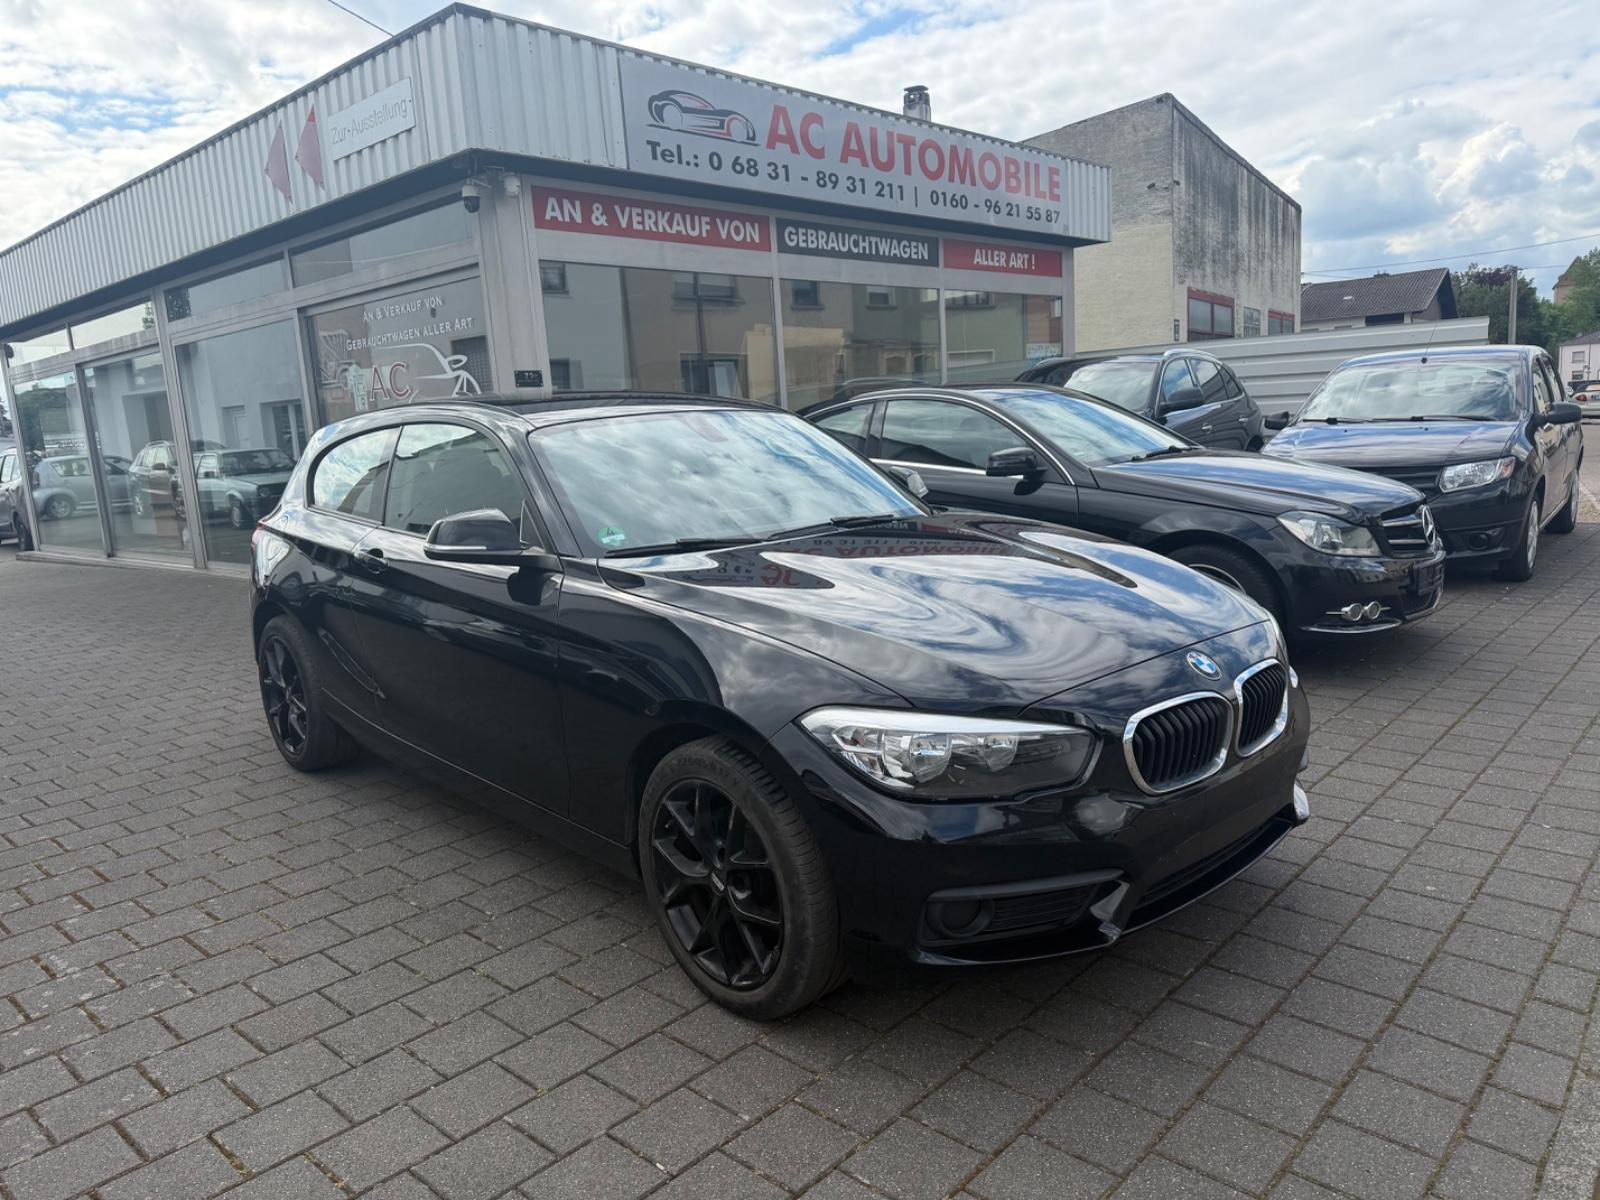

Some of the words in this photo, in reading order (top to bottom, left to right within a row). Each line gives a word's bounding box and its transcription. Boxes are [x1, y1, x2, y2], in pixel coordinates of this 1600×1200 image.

[766, 104, 826, 160] AC
[839, 122, 1061, 202] AUTOMOBILE
[646, 140, 700, 168] Tel.:
[708, 151, 723, 171] 0
[731, 155, 760, 177] 68
[767, 161, 790, 183] 31
[816, 170, 840, 190] 89
[846, 175, 866, 195] 31
[874, 180, 905, 201] 211
[930, 190, 969, 210] 0160
[984, 198, 1002, 215] 96
[1006, 202, 1021, 218] 21
[1026, 206, 1042, 222] 55
[1045, 209, 1061, 224] 87
[545, 196, 583, 225] AN
[591, 202, 609, 227] &
[614, 204, 711, 238] VERKAUF
[715, 217, 761, 243] VON
[784, 226, 929, 261] GEBRAUCHTWAGEN
[973, 248, 1007, 268] ALLER
[1008, 250, 1030, 270] ART
[423, 320, 452, 337] ALLER
[369, 361, 411, 402] AC
